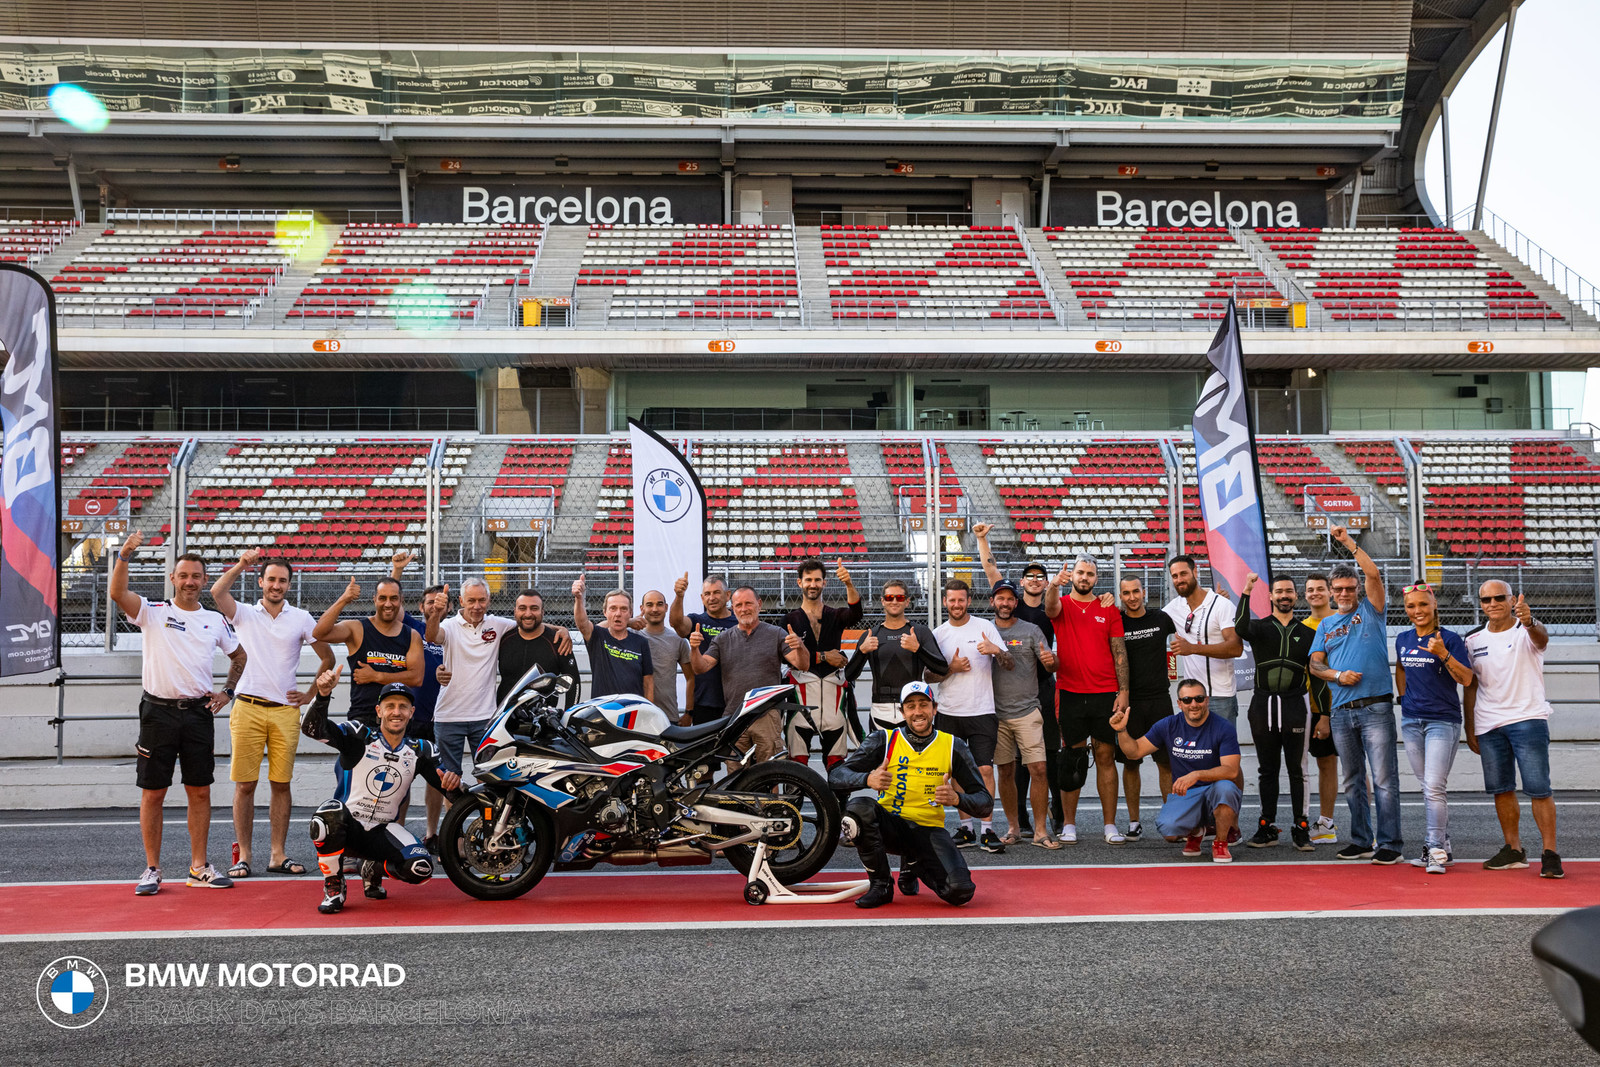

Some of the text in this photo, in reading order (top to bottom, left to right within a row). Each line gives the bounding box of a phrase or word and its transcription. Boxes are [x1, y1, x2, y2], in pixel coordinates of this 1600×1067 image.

[448, 161, 461, 170] 24
[686, 162, 699, 171] 25
[900, 164, 913, 173] 26
[1125, 166, 1137, 175] 27
[1323, 167, 1336, 176] 28
[463, 187, 673, 225] Barcelona
[1097, 191, 1300, 228] Barcelona
[323, 341, 339, 351] 18
[719, 341, 734, 351] 19
[1105, 341, 1120, 351] 20
[1477, 342, 1491, 352] 21
[69, 521, 120, 531] 17 18
[494, 520, 544, 529] 18 19
[911, 519, 959, 528] 19 20
[1314, 518, 1362, 526] 20 21
[1124, 632, 1154, 640] OTORSPORT
[367, 650, 406, 662] QUIKSILVE
[1172, 751, 1204, 760] MOTORSPORT
[892, 755, 910, 817] RACKDAYS
